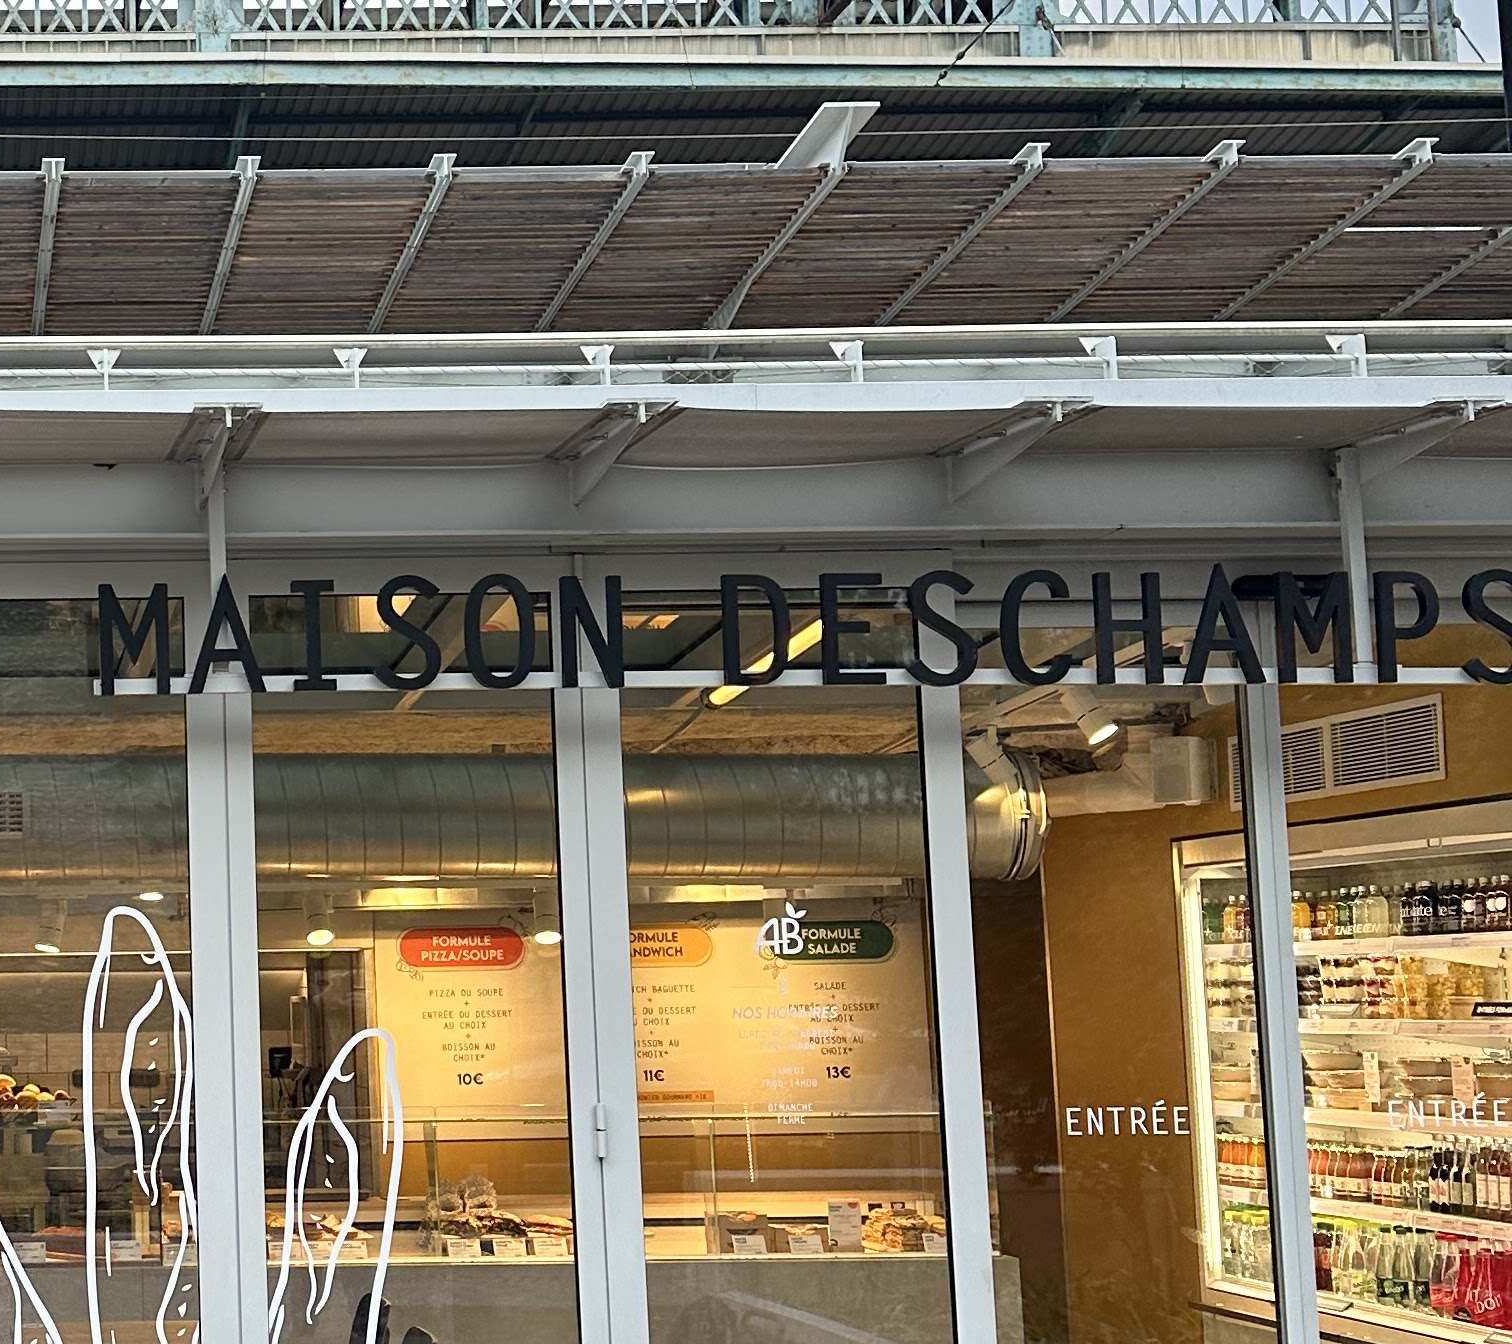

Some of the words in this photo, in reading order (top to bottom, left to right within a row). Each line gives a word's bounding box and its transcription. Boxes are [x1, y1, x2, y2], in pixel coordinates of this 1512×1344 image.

[98, 573, 625, 696] MAISON
[720, 562, 1512, 686] DESCHAMPS
[629, 931, 679, 943] ORMULE
[801, 928, 862, 940] FORMULE
[432, 935, 492, 947] FORMULE
[630, 946, 684, 958] NDWICH
[807, 942, 857, 954] SALADE
[420, 949, 505, 962] PIZZA/SOUPE
[652, 984, 695, 993] BAGUETTE
[814, 981, 846, 991] SALADE
[429, 989, 455, 998] PIZZA
[460, 988, 472, 997] OU
[477, 987, 504, 997] SOUPE
[642, 1007, 654, 1015] OU
[658, 1006, 696, 1015] DESSERT
[842, 1002, 880, 1012] DESSERT
[422, 1009, 454, 1020] ENTRÉE
[459, 1011, 470, 1019] OU
[475, 1009, 513, 1019] DESSERT
[732, 1007, 762, 1020] NOS
[443, 1022, 454, 1030] AU
[459, 1021, 487, 1029] CHOIX
[643, 1018, 670, 1026] CHOIX
[634, 1039, 664, 1048] ISSON
[668, 1039, 680, 1047] AU
[809, 1036, 847, 1045] BOISSON
[852, 1036, 864, 1044] AU
[442, 1043, 480, 1052] BOISSON
[484, 1042, 496, 1051] AU
[643, 1069, 665, 1082] 11€
[825, 1066, 851, 1079] 13€
[457, 1073, 484, 1085] 10€
[767, 1103, 814, 1112] DIMANCHE
[1387, 1092, 1510, 1128] ENTRÉE
[1066, 1100, 1190, 1136] ENTRÉE
